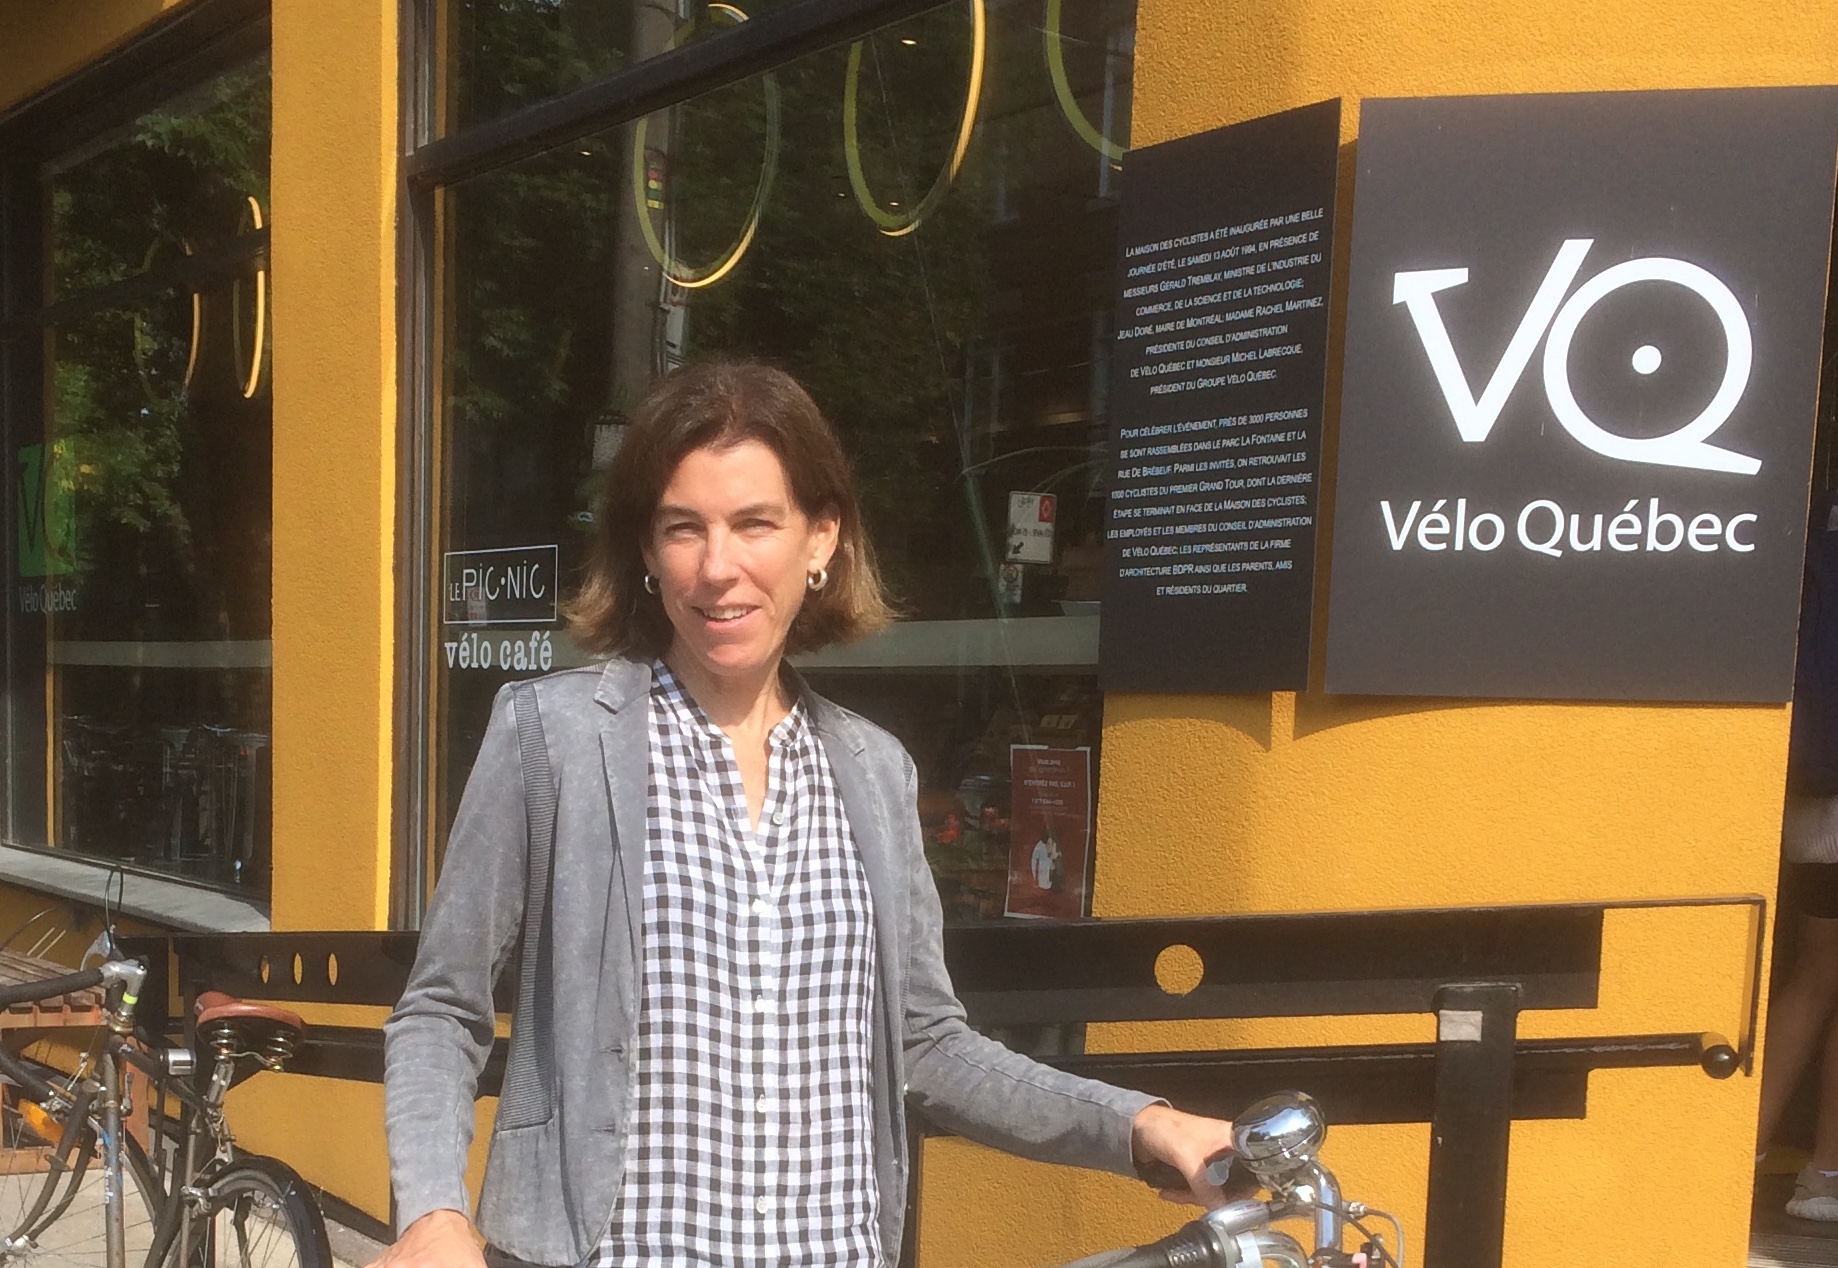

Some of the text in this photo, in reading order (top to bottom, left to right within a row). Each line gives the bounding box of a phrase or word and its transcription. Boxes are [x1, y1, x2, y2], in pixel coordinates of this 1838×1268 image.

[1393, 239, 1762, 475] VQ
[1378, 497, 1758, 558] Vélo Québec
[19, 582, 77, 614] Vélo Québec
[450, 582, 461, 602] LE
[444, 630, 553, 671] vélo café
